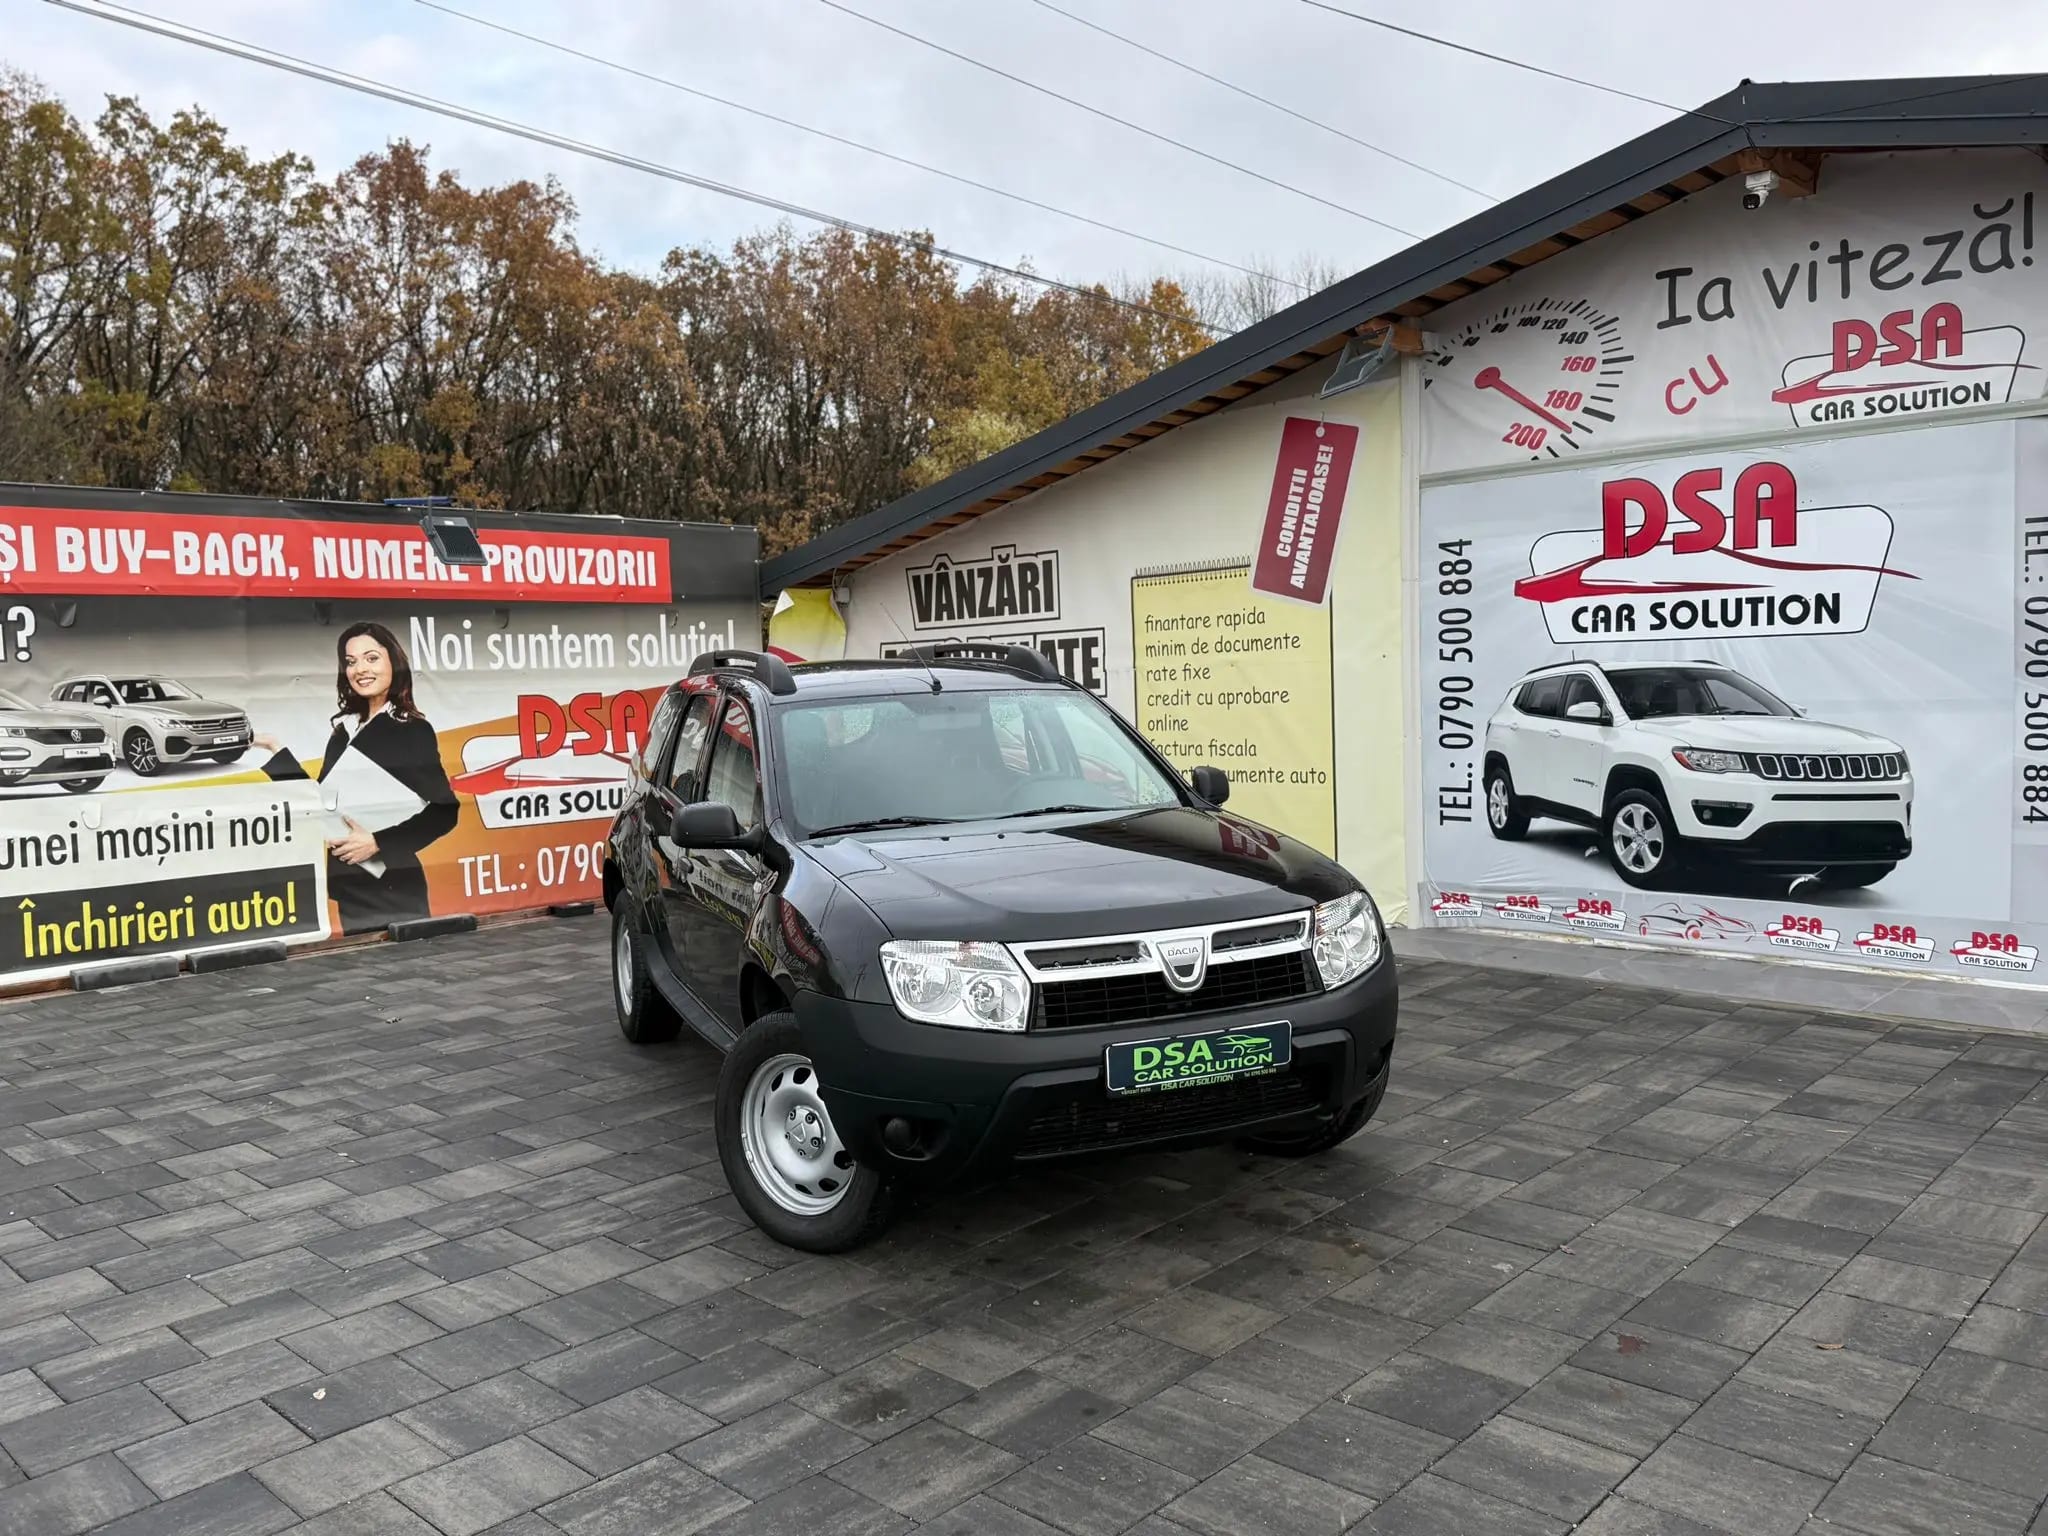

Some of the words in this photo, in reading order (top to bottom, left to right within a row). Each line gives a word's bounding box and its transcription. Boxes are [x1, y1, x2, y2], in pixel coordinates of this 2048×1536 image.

[1656, 267, 1735, 329] Ia
[1762, 192, 2034, 309] viteză!
[1517, 316, 1541, 327] 100
[1541, 318, 1568, 330] 120
[1558, 331, 1588, 344] 140
[1833, 302, 1963, 373] DSA
[1561, 356, 1596, 372] 160
[1665, 354, 1729, 415] cu
[1543, 389, 1583, 411] 180
[1810, 401, 1855, 423] CAR
[1864, 382, 1991, 417] SOLUTION
[1502, 422, 1548, 450] 200
[1276, 468, 1308, 558] CONDITII
[1290, 444, 1334, 589] AVANTAJOASE!
[1602, 461, 1797, 559] DSA
[55, 526, 299, 581] BUY-BACK,
[480, 543, 657, 587] PROVIZORII
[1438, 539, 1472, 596] 884
[911, 552, 1055, 623] VÂNZĂRI
[1145, 614, 1211, 633] finantare
[1216, 606, 1265, 631] rapida
[1571, 605, 1636, 633] CAR
[1649, 592, 1841, 631] SOLUTION
[409, 616, 473, 670] Noi
[487, 624, 614, 670] suntem
[1145, 638, 1186, 658] minim
[1191, 637, 1209, 655] de
[1214, 633, 1301, 655] documente
[1438, 608, 1473, 662] 500
[1146, 668, 1177, 682] rate
[1183, 664, 1211, 681] fixe
[1147, 690, 1191, 707] credit
[1196, 694, 1213, 706] cu
[1218, 686, 1290, 710] aprobare
[518, 690, 649, 759] DSA
[1147, 713, 1189, 732] online
[1439, 676, 1474, 749] 0790
[1208, 738, 1257, 758] fiscala
[1290, 767, 1327, 784] auto
[1439, 762, 1473, 826] TEL.:
[500, 795, 549, 820] CAR
[0, 820, 79, 870] unei
[97, 811, 214, 866] mașini
[229, 800, 293, 847] noi!
[458, 853, 528, 897] TEL.:
[537, 841, 604, 886] 0790
[1440, 892, 1470, 905] DSA
[1507, 896, 1539, 909] DSA
[1578, 899, 1612, 915] DSA
[18, 895, 195, 958] Închirieri
[208, 881, 297, 935] auto!
[1503, 911, 1516, 919] CAR
[1517, 912, 1546, 922] SOLUTION
[1573, 919, 1586, 927] CAR
[1587, 920, 1620, 929] SOLUTION
[1783, 915, 1823, 934] DSA
[1775, 937, 1790, 945] CAR
[1791, 938, 1830, 950] SOLUTION
[1874, 924, 1917, 943] DSA
[1972, 932, 2018, 951] DSA
[1168, 946, 1199, 957] DACIA
[1866, 947, 1882, 955] CAR
[1884, 948, 1926, 960] SOLUTION
[1964, 956, 1981, 965] CAR
[1983, 957, 2028, 970] SOLUTION
[1134, 1039, 1213, 1071] DSA
[1134, 1067, 1174, 1082] CAR
[1180, 1052, 1273, 1077] SOLUTION
[1161, 1081, 1178, 1091] DSA
[1179, 1079, 1195, 1089] CAR
[1196, 1073, 1234, 1086] SOLUTION
